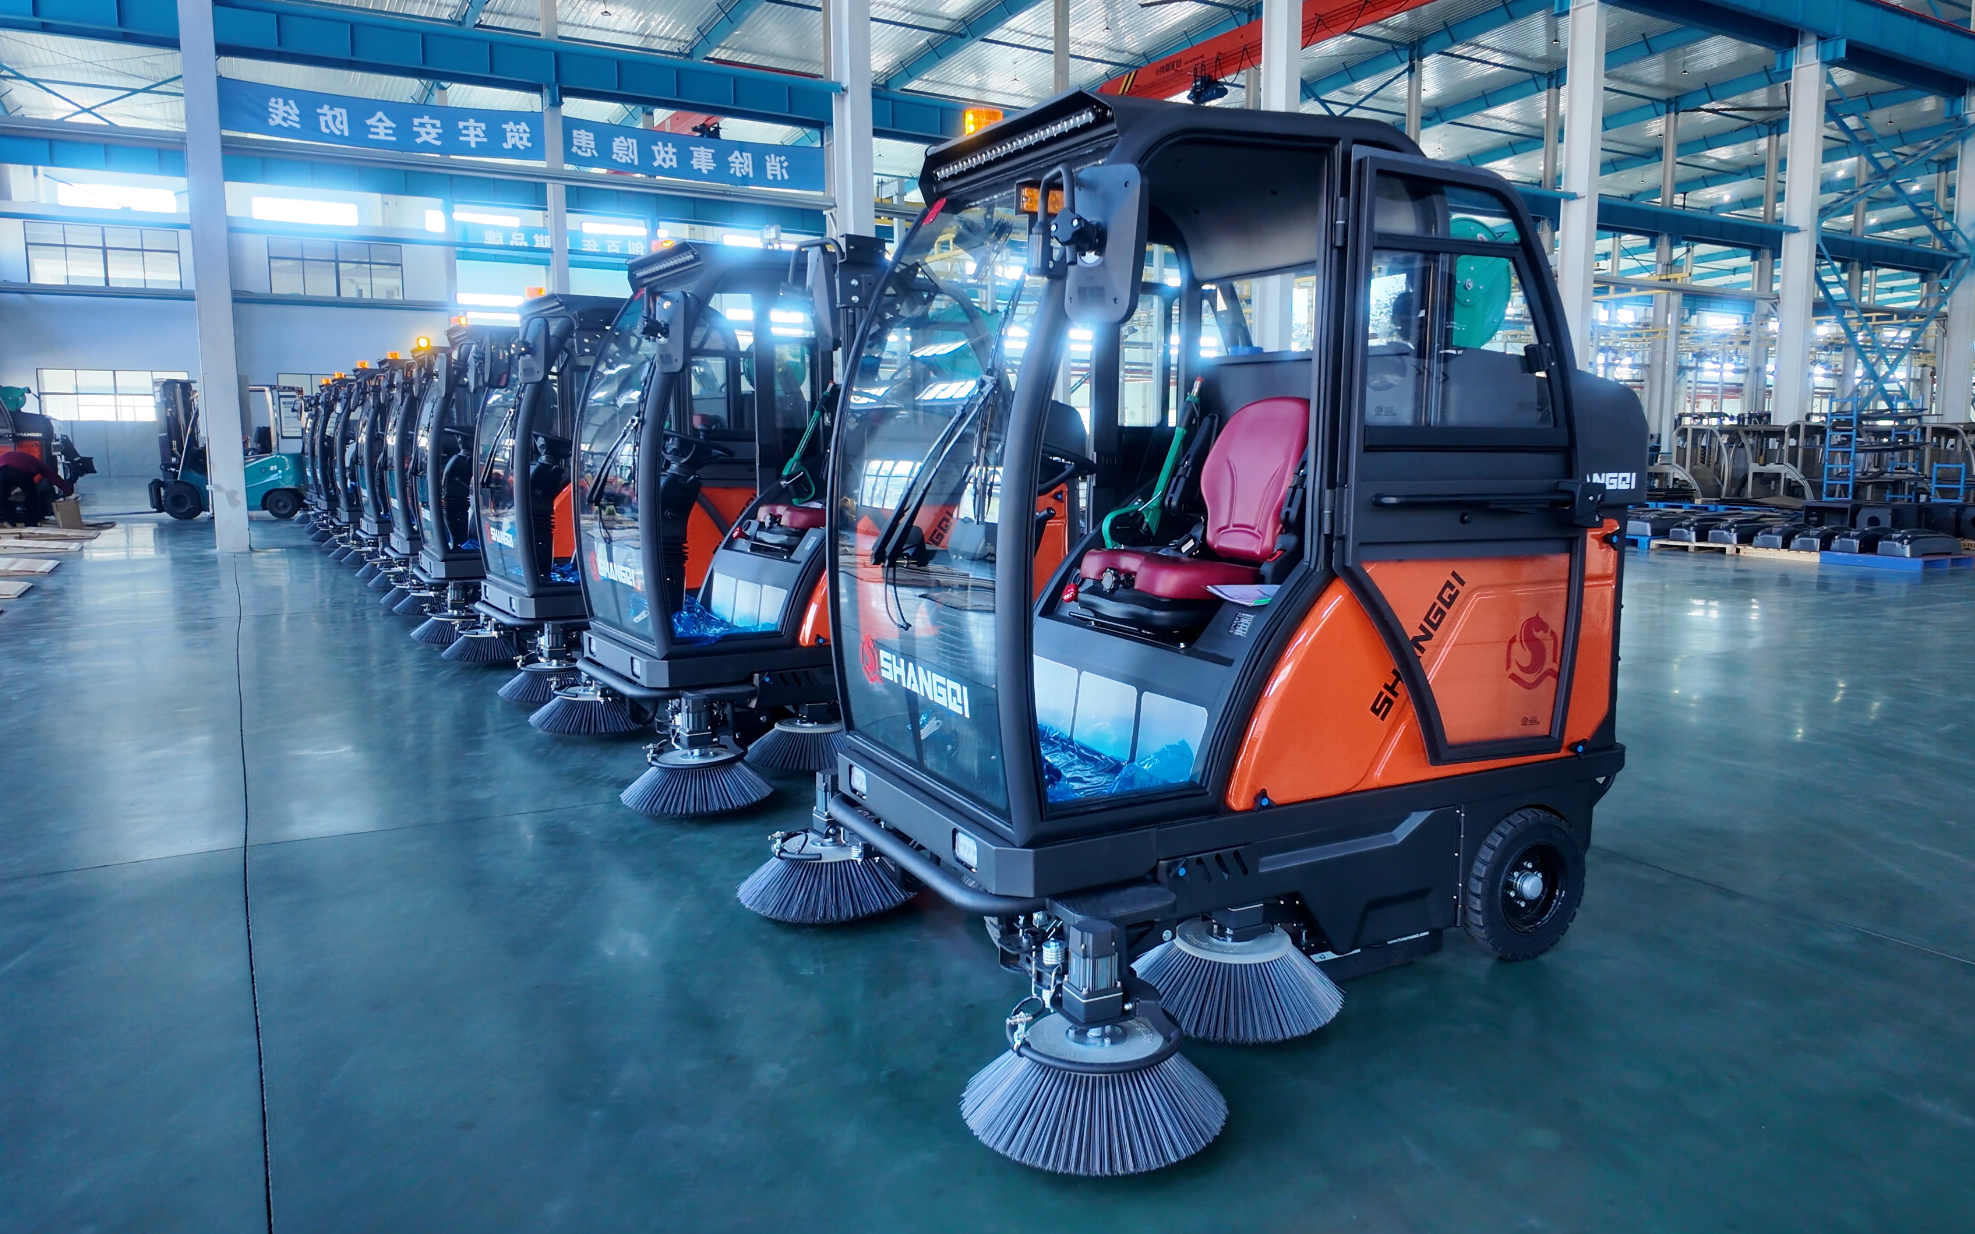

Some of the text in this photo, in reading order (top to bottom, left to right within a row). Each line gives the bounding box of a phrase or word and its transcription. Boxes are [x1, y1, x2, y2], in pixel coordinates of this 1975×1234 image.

[1586, 472, 1636, 490] NGQI
[1369, 570, 1467, 722] SHNGQI
[879, 649, 971, 719] SHANGQI
